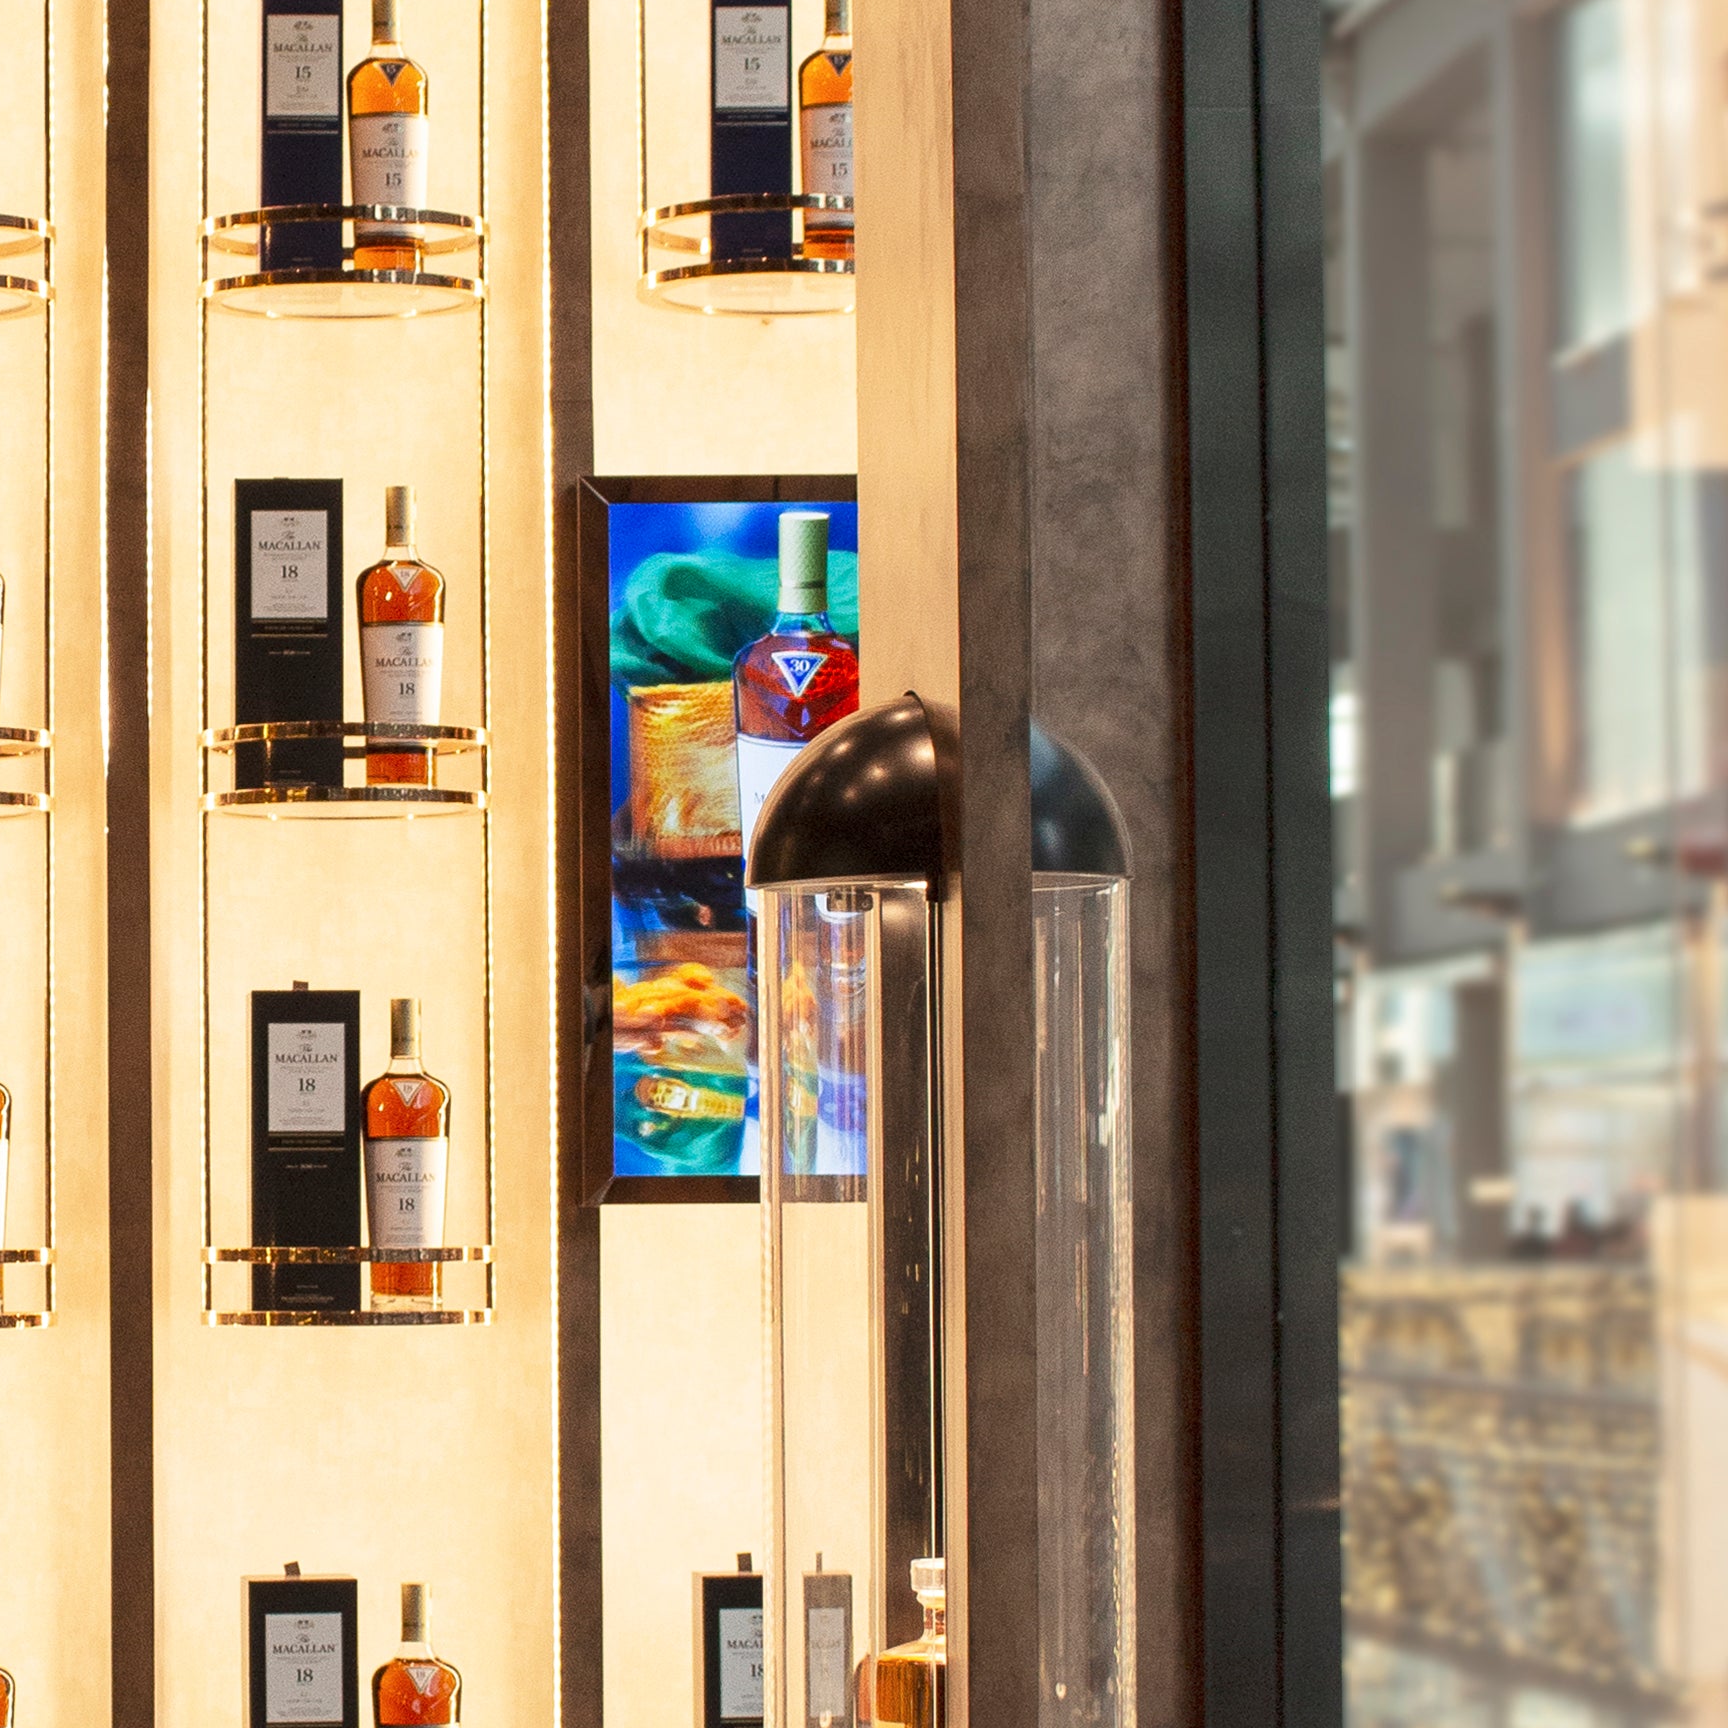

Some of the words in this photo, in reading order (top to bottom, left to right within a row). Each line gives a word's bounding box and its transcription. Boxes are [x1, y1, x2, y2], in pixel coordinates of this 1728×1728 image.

[721, 34, 782, 45] MACALLAN
[273, 42, 333, 53] MACALLAN
[744, 57, 760, 71] 15
[295, 65, 311, 79] 15
[810, 138, 852, 149] MACALL
[832, 163, 848, 177] 15
[385, 172, 402, 187] 15
[258, 540, 321, 551] MACALLAN
[281, 565, 298, 579] 18
[789, 659, 810, 673] 30
[398, 682, 415, 695] 18
[275, 1053, 338, 1064] MACALLAN
[298, 1077, 316, 1092] 18
[376, 1172, 437, 1183] MACALLAN
[399, 1198, 415, 1211] 18
[273, 1643, 335, 1654] MACALLAN
[727, 1639, 763, 1649] MACA
[296, 1669, 313, 1683] 18
